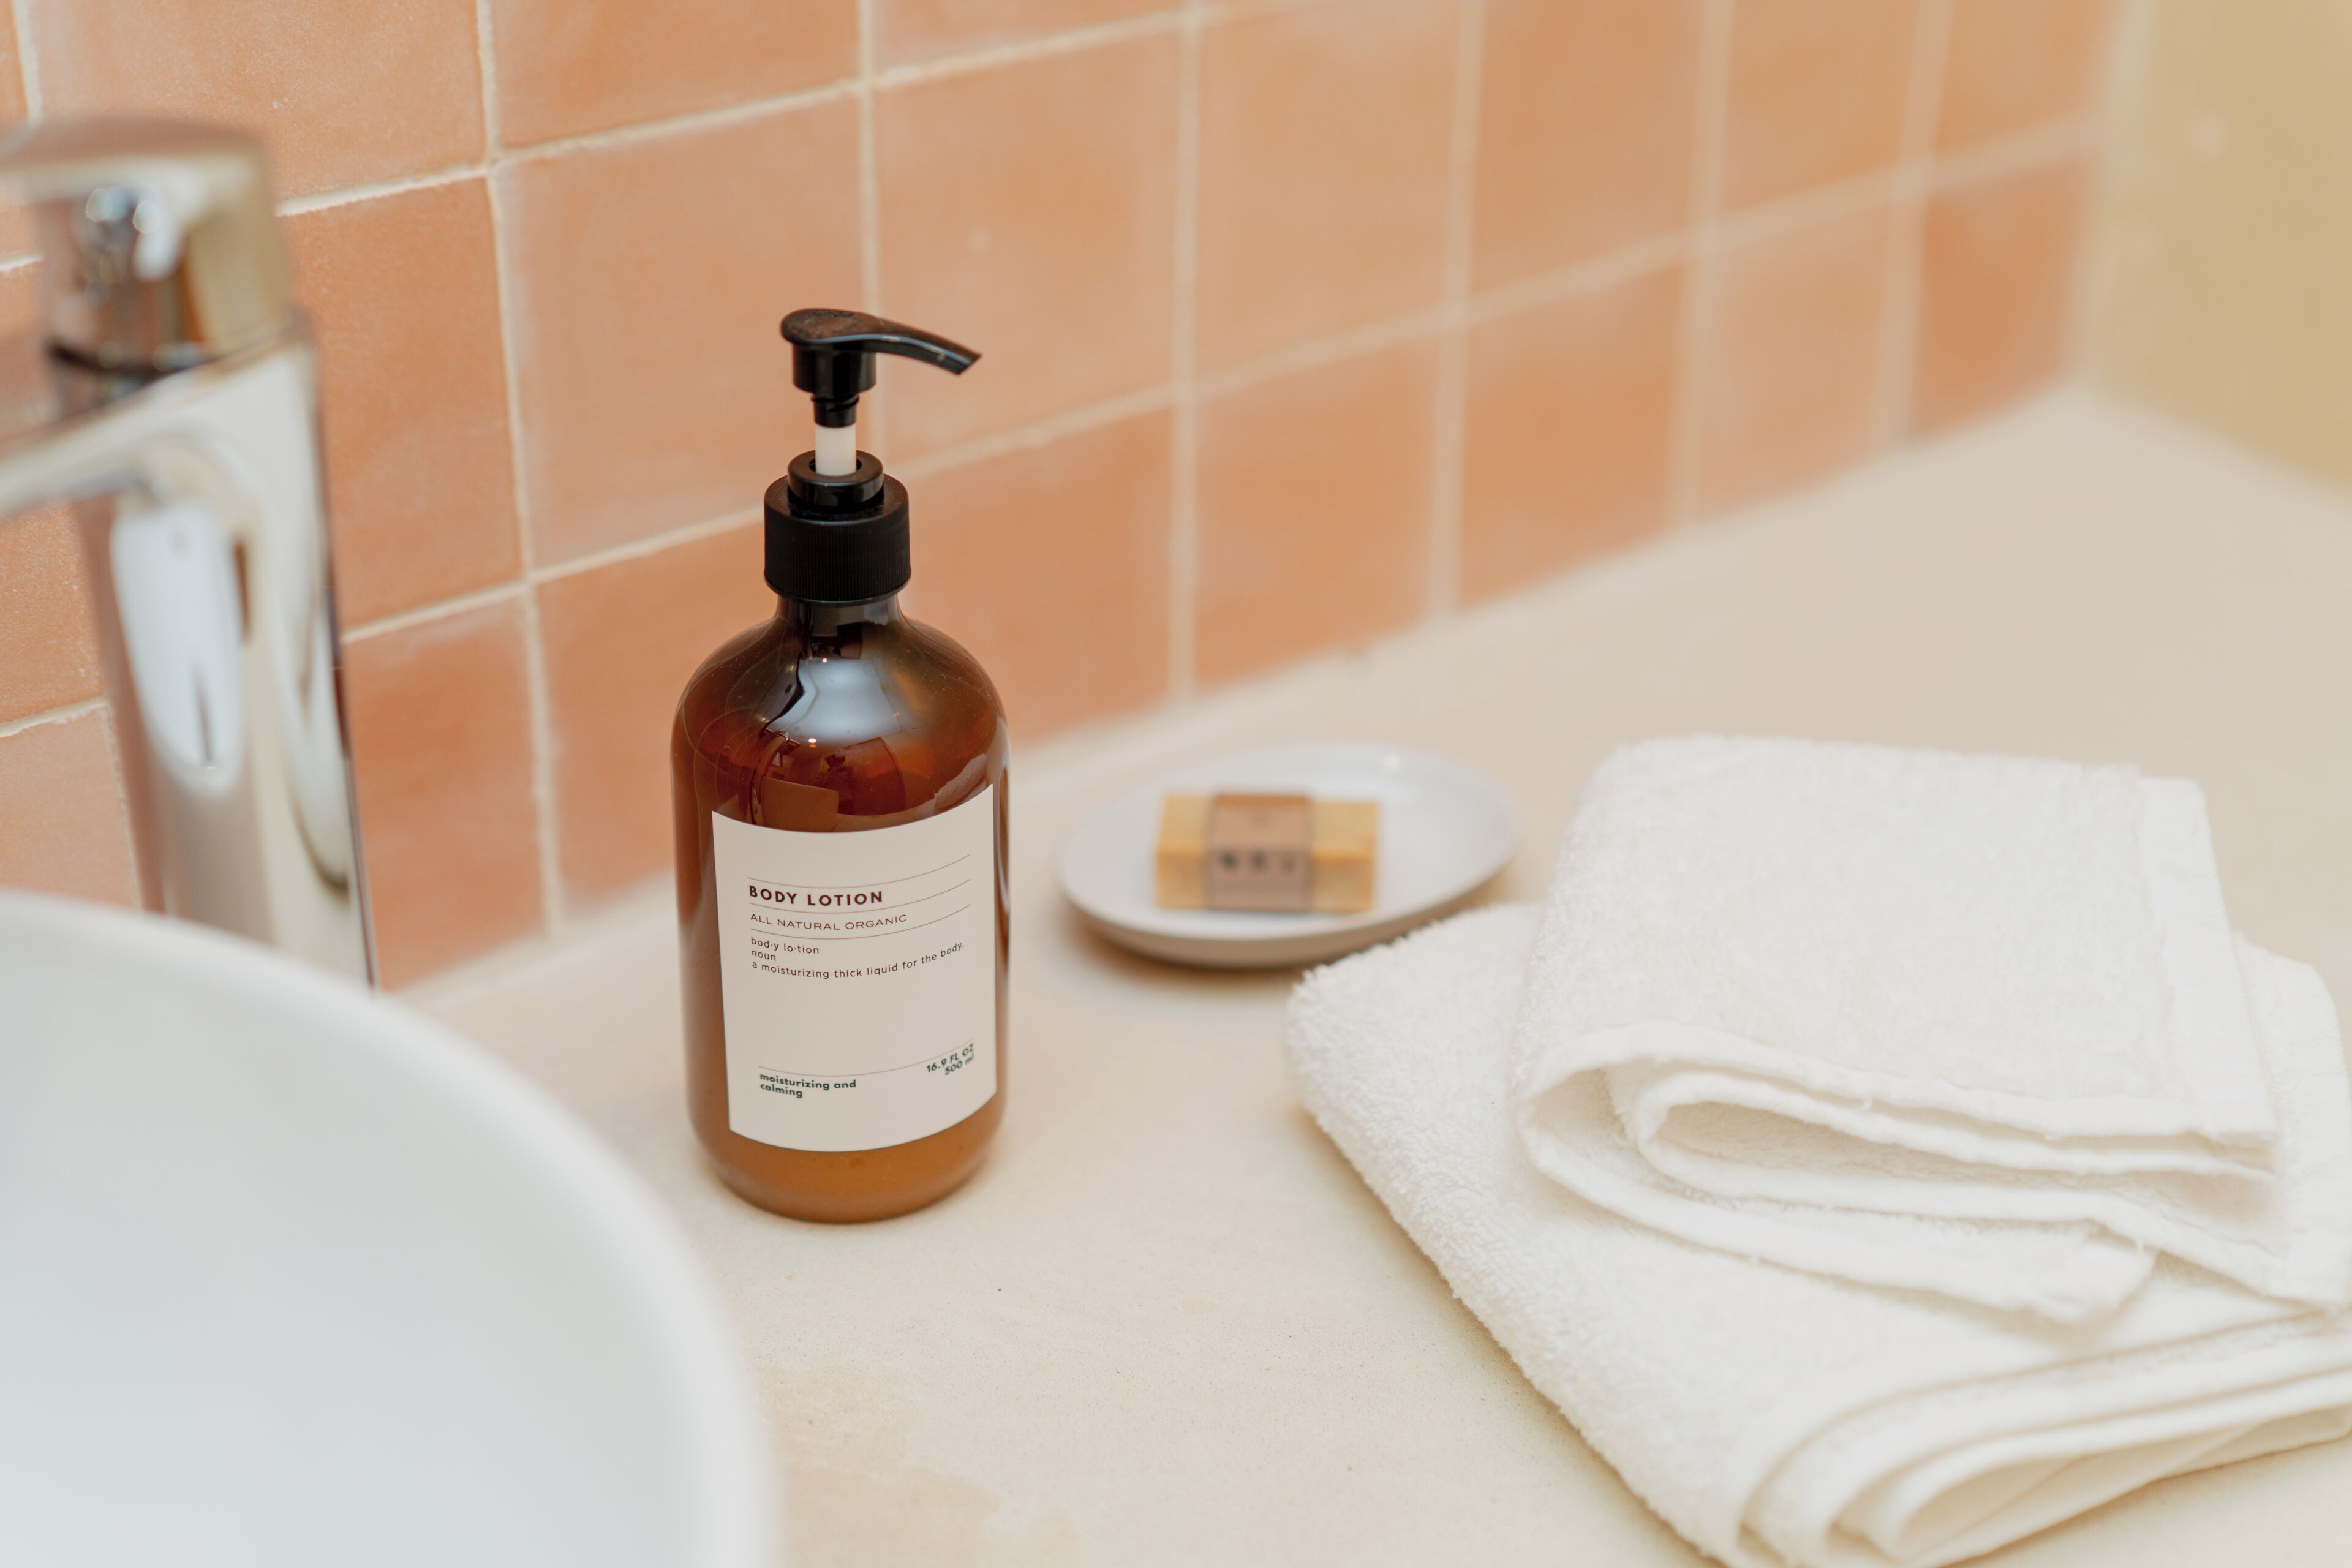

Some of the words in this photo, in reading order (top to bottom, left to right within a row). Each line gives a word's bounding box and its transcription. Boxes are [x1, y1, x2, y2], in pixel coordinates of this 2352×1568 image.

[748, 884, 798, 905] BODY
[807, 891, 883, 907] LOTION
[750, 913, 774, 925] ALL
[777, 919, 841, 930] NATURAL
[845, 914, 907, 930] ORGANIC
[752, 950, 777, 961] noun
[761, 963, 829, 980] moisturizing
[834, 968, 862, 978] thick
[867, 963, 898, 976] liquid
[902, 960, 918, 970] for
[921, 954, 937, 964] the
[940, 942, 965, 958] body.
[926, 1058, 948, 1073] 16.9
[949, 1053, 960, 1064] FL
[962, 1043, 974, 1057] OZ
[944, 1060, 963, 1076] 500
[965, 1052, 974, 1065] ml
[760, 1073, 830, 1091] moisturizing
[833, 1079, 857, 1089] and
[760, 1082, 803, 1099] calming
